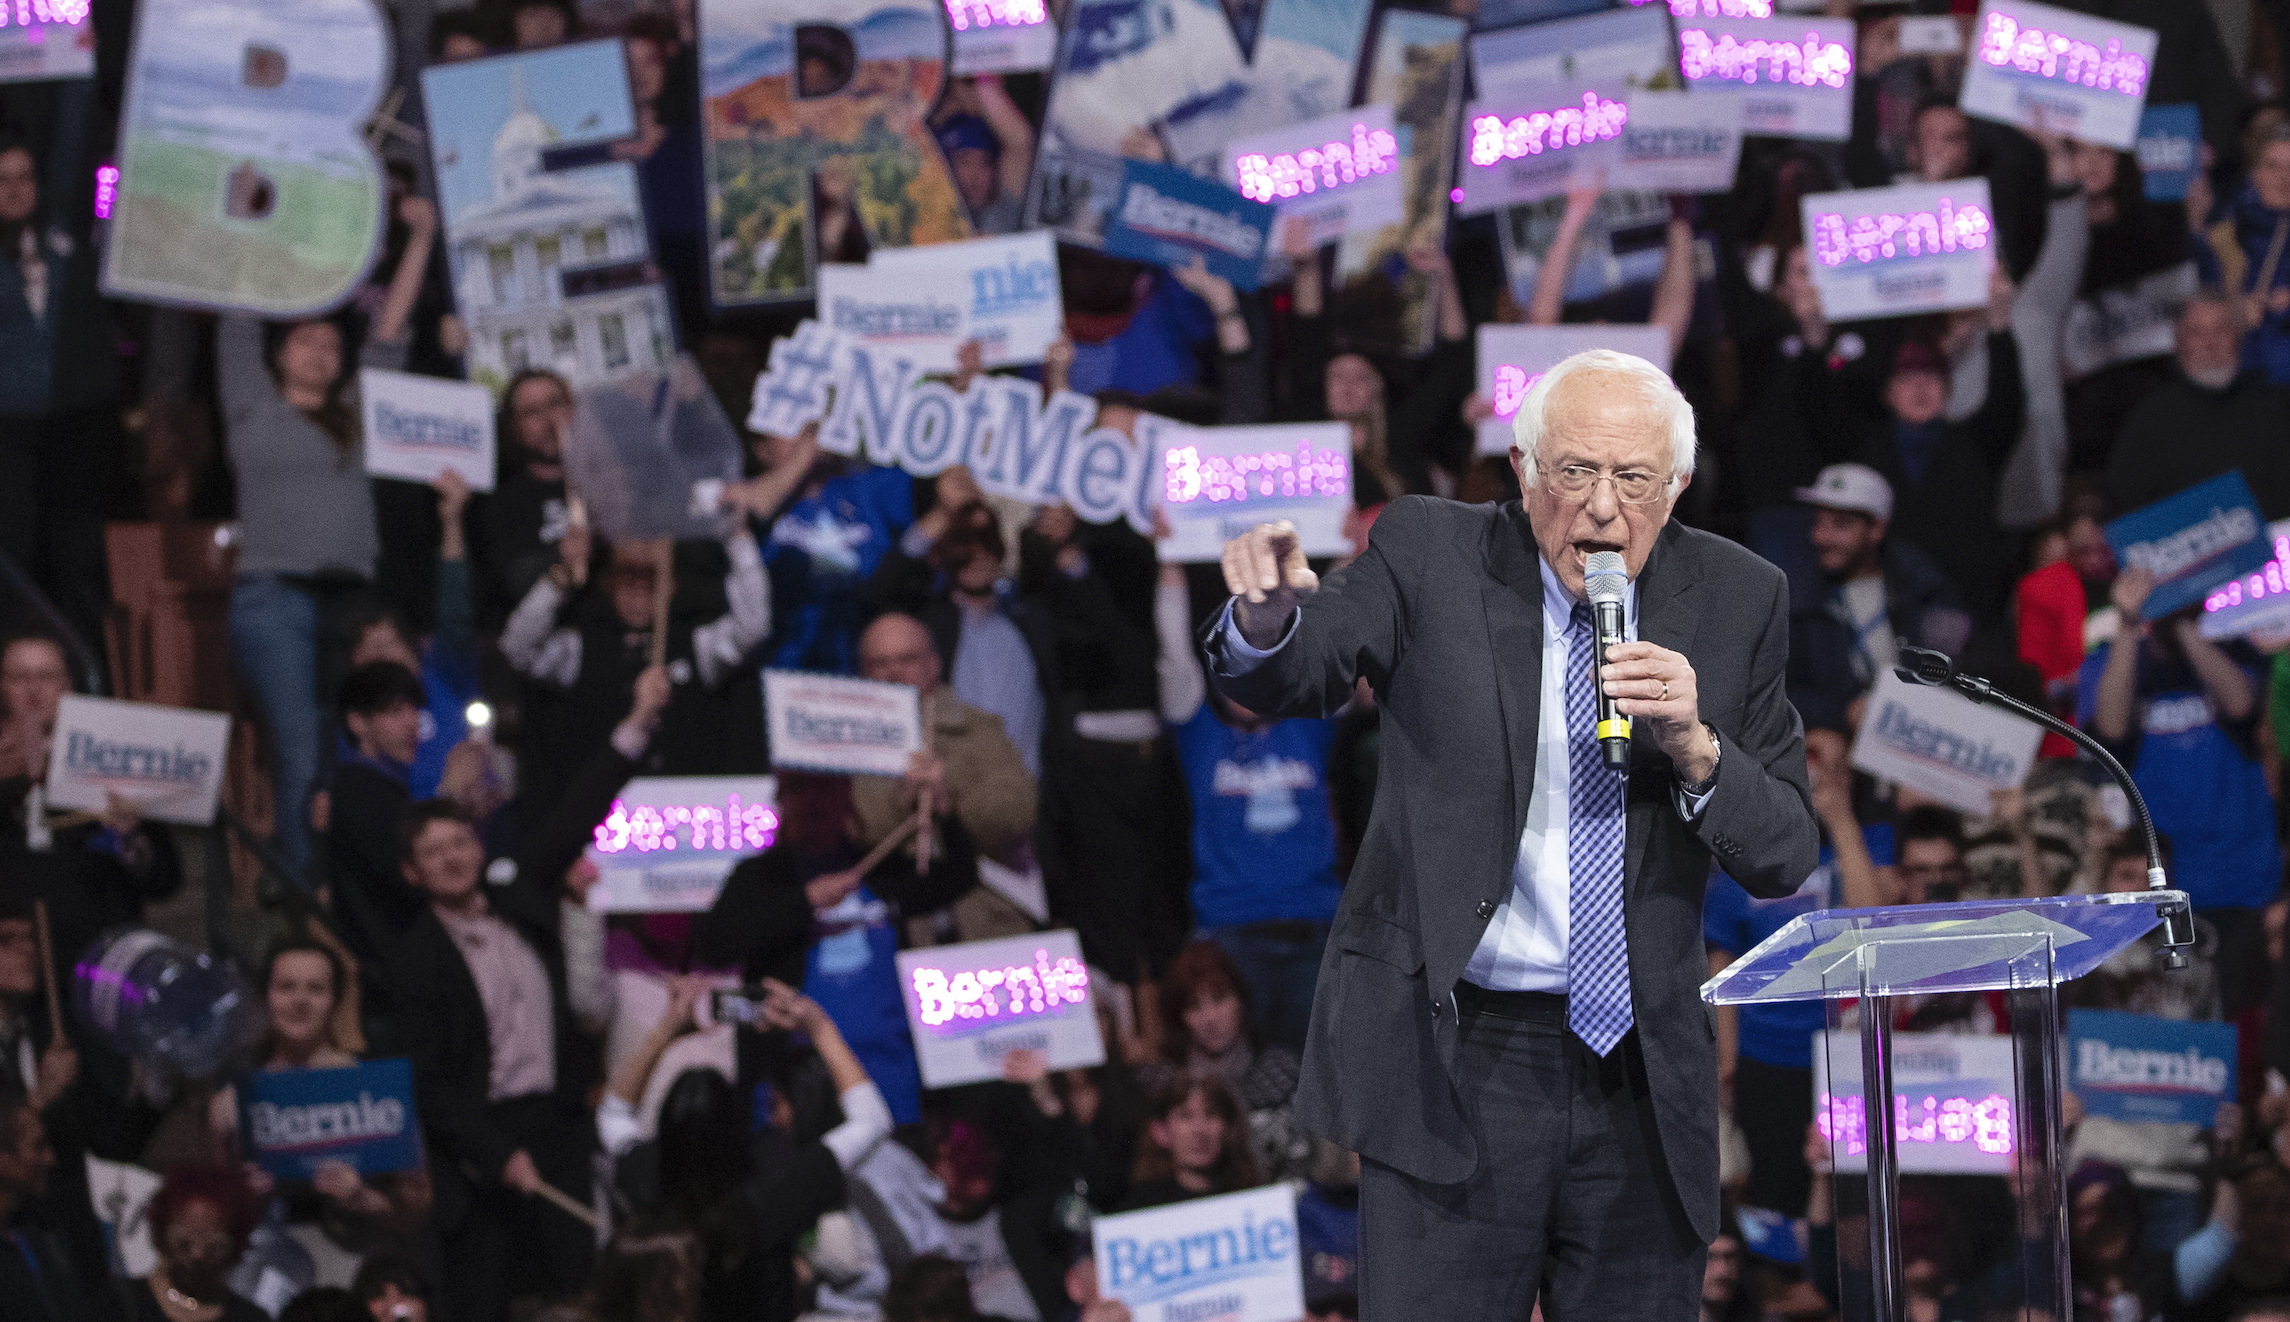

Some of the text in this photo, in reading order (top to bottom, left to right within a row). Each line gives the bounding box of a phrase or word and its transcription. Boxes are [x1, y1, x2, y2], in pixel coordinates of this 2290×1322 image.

[1681, 28, 1851, 88] Bernie
[1979, 10, 2145, 96] Bernie
[1236, 122, 1397, 203] Bernie
[1471, 91, 1628, 166] Bernie
[1123, 182, 1264, 260] Bernie
[1814, 196, 1990, 267] Bernie
[832, 294, 963, 336] Bernie
[374, 400, 482, 450] Bernie
[1160, 438, 1347, 503] Bernie
[66, 730, 210, 785] Bernie
[785, 706, 909, 750] Bernie
[1873, 700, 2017, 784] Bernie
[910, 948, 1087, 1028] Bernie
[2076, 1038, 2228, 1094] Bernie
[250, 1090, 404, 1146] Bernie
[1106, 1208, 1293, 1290] Bernie
